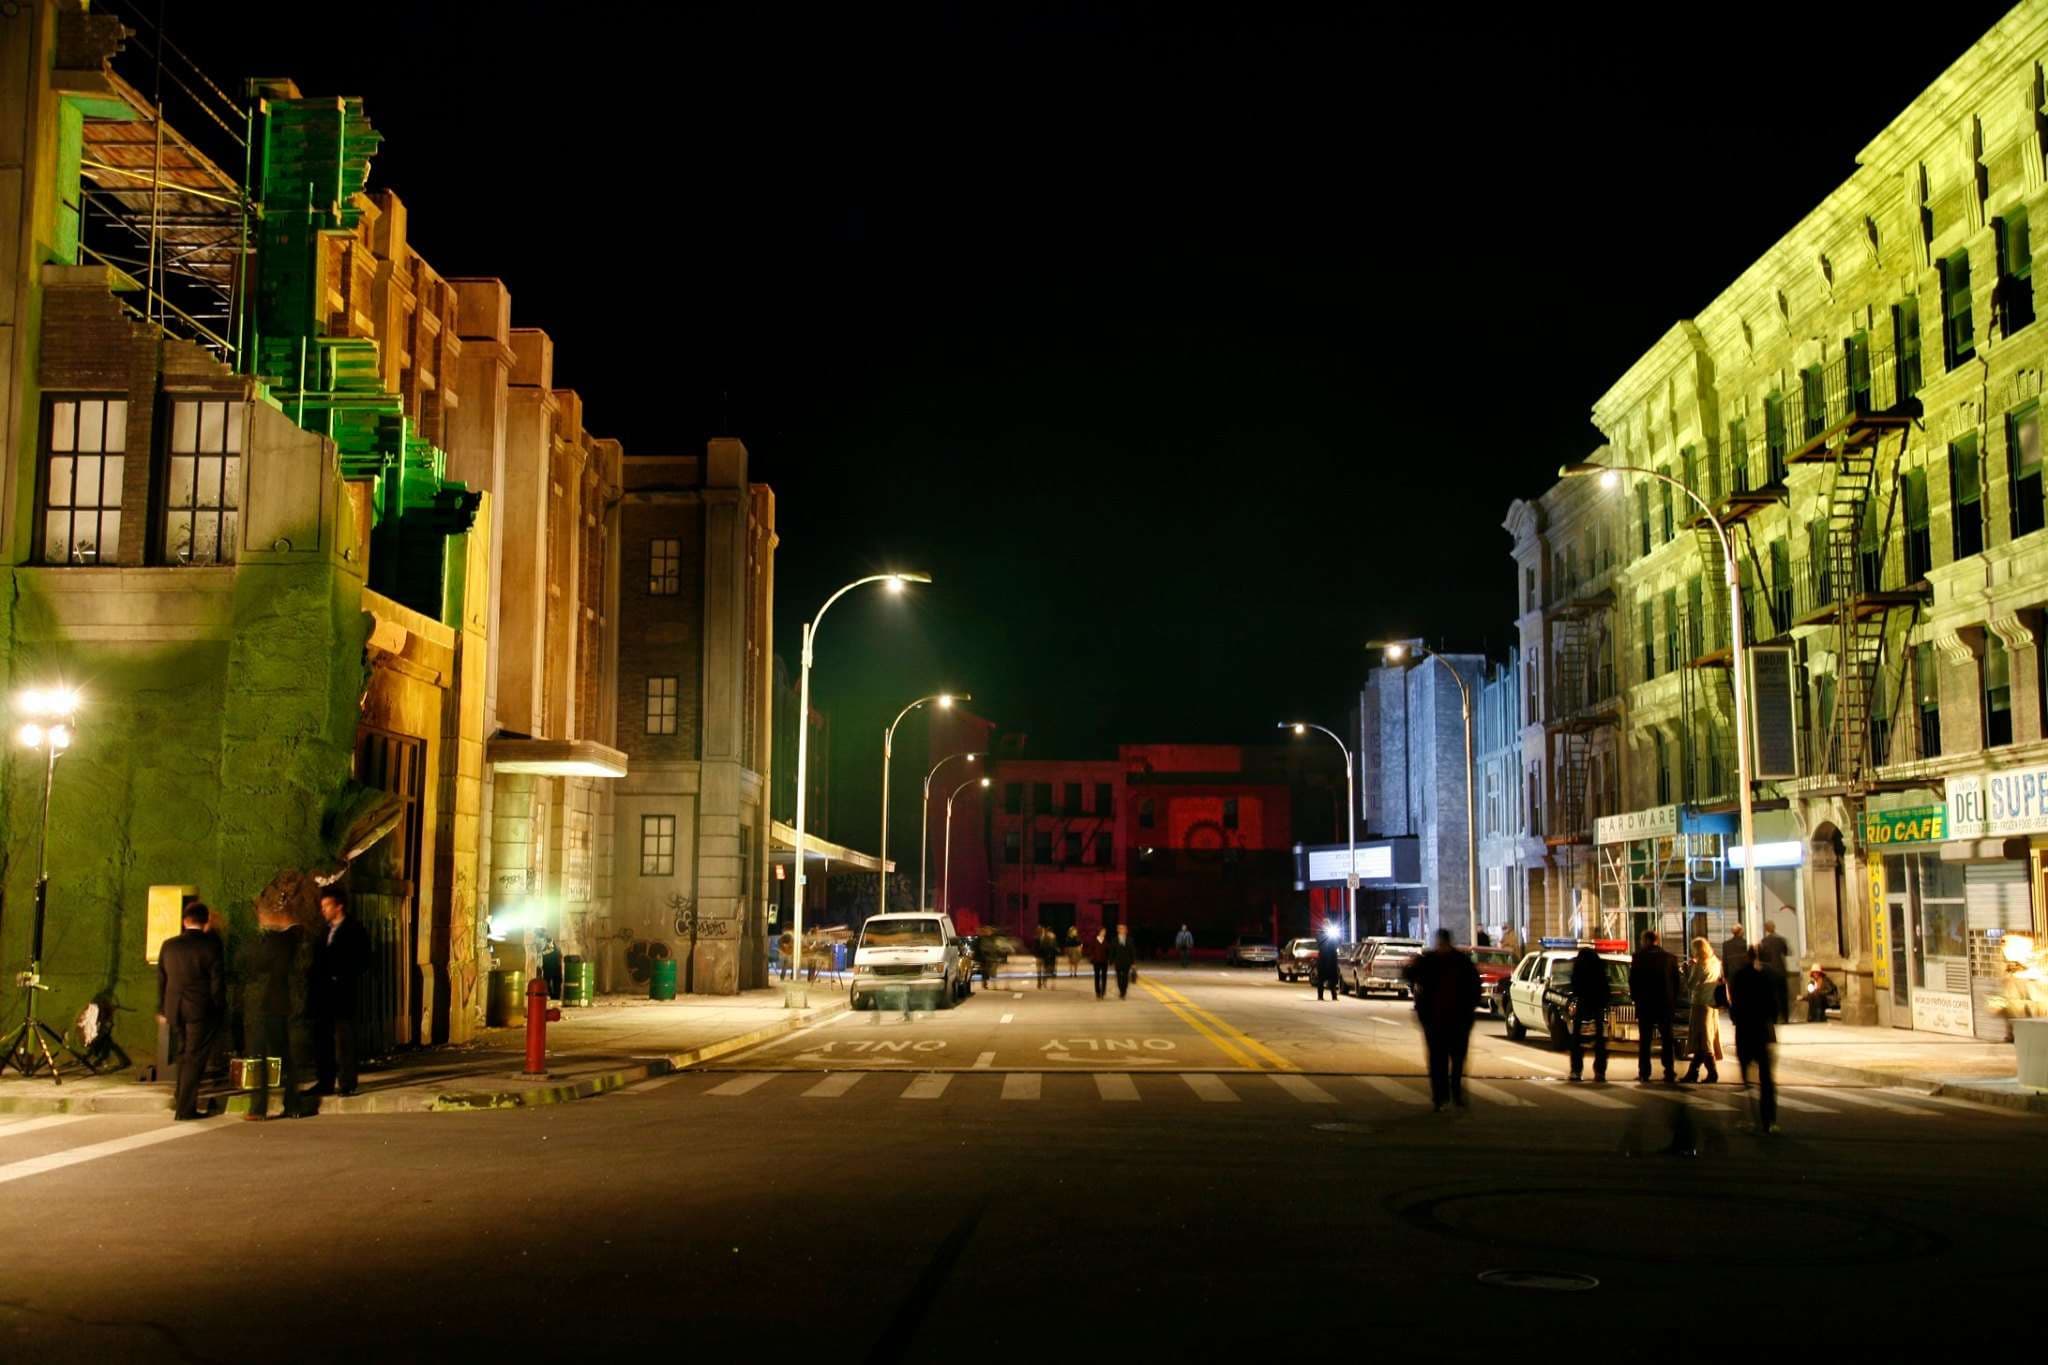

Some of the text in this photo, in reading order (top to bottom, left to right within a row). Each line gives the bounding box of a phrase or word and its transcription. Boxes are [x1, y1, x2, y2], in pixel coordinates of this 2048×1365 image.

[1955, 789, 1987, 824] DELI
[1600, 808, 1675, 833] HARDWARE
[1867, 824, 1891, 844] RIO
[1894, 815, 1943, 842] CAFE
[1872, 881, 1884, 961] OPEN
[808, 1039, 948, 1053] ONLY
[1039, 1038, 1177, 1051] ONLY
